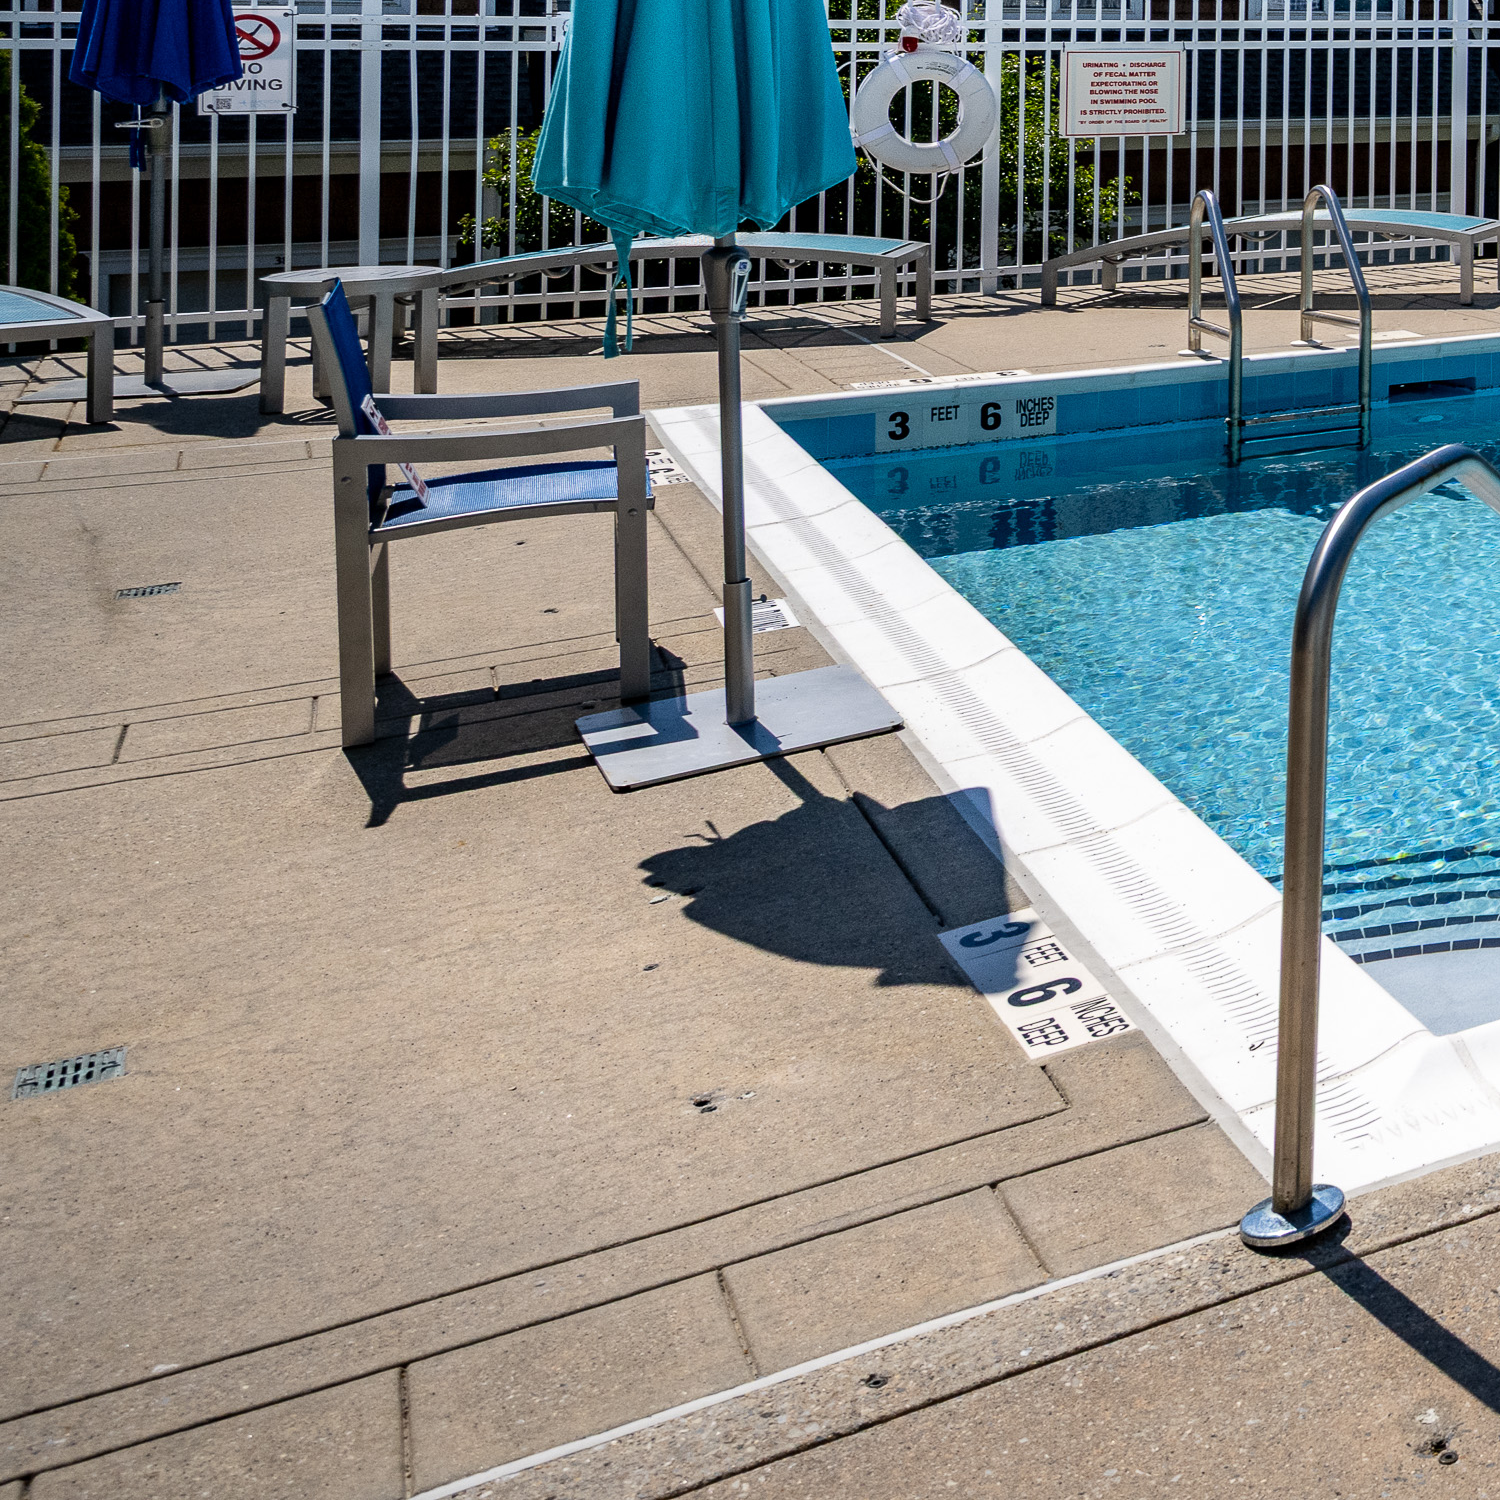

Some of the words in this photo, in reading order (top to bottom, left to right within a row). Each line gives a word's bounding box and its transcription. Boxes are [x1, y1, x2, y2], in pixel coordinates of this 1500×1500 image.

[888, 411, 910, 441] 3
[930, 405, 960, 422] FEET
[980, 402, 1002, 431] 6
[1016, 396, 1054, 414] INCHES
[1020, 411, 1049, 427] DEEP
[959, 921, 1030, 948] 3
[1024, 942, 1069, 968] FEET
[1007, 977, 1082, 1007] 6
[1070, 995, 1130, 1038] INCHES
[1017, 1017, 1070, 1047] DEEP
